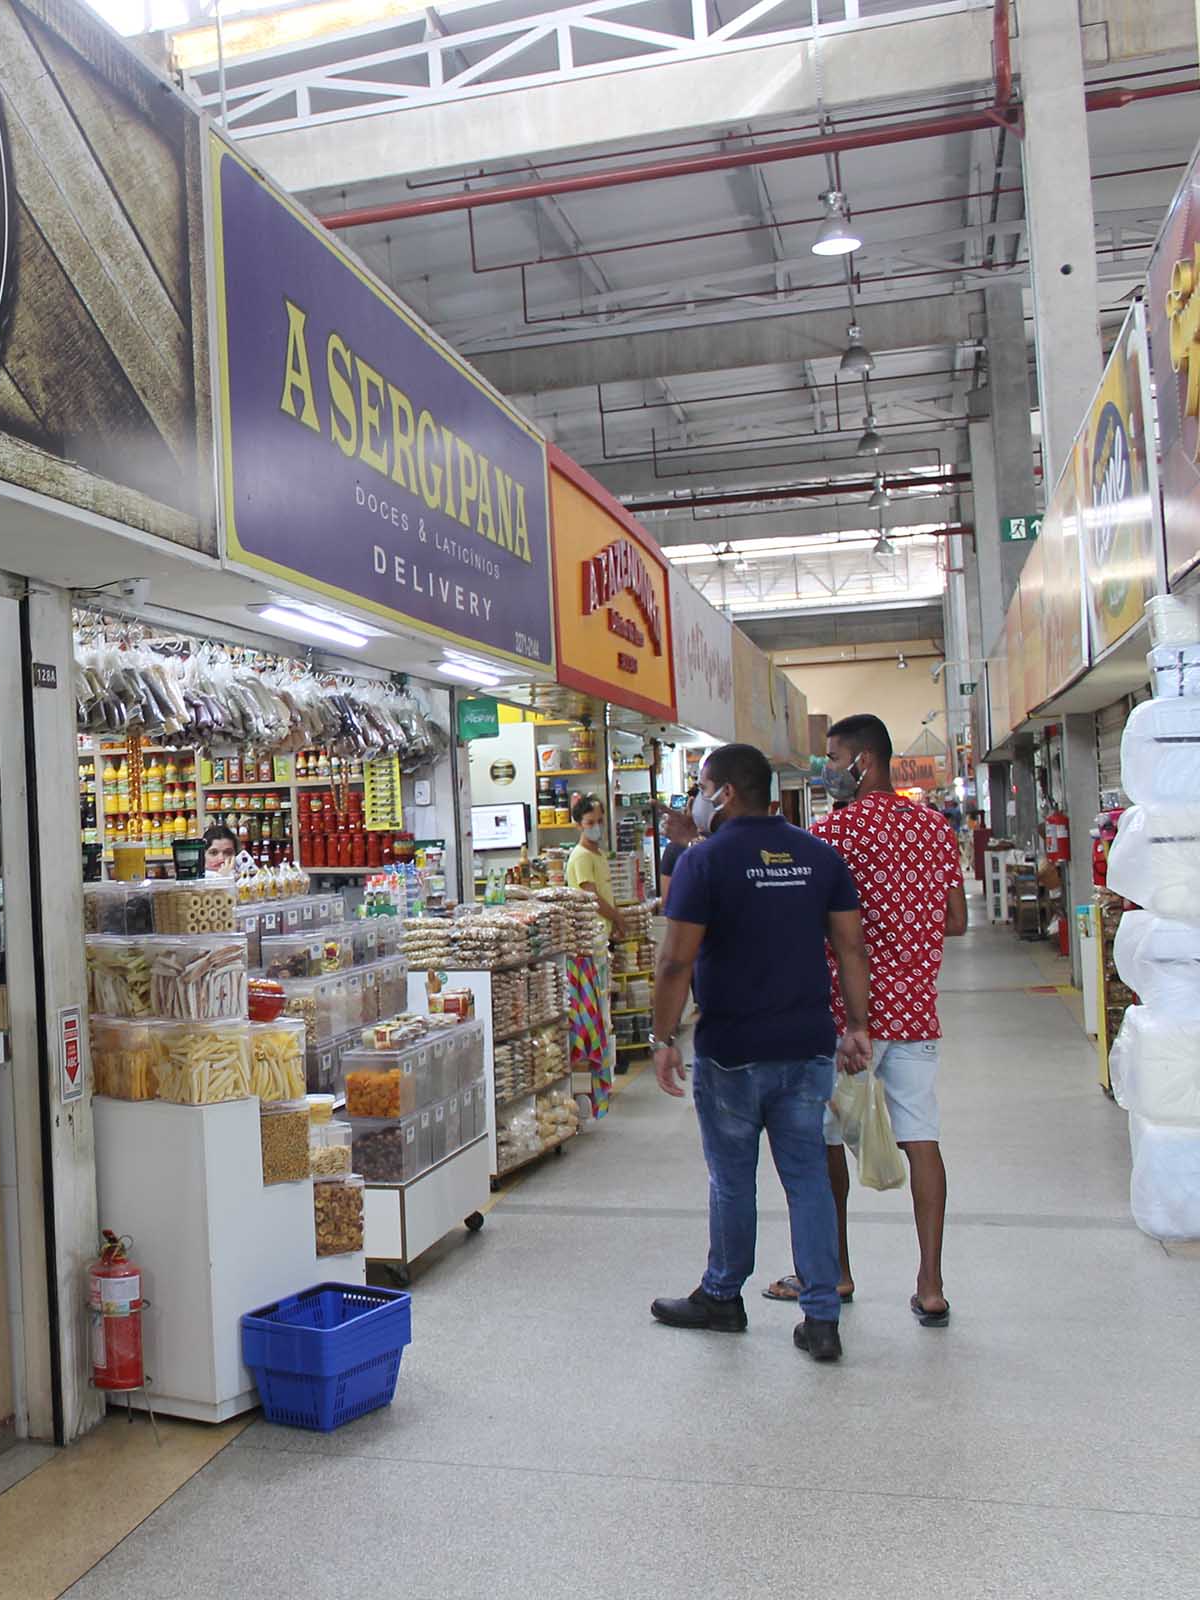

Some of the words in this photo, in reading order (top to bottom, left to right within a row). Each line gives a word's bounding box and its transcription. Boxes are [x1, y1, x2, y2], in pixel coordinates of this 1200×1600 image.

[279, 299, 321, 434] A
[326, 332, 533, 565] SERGIPANA
[354, 482, 411, 533] DOCES
[417, 518, 429, 544] &
[433, 531, 502, 580] LATICÍNIOS
[372, 544, 494, 622] DELIVERY
